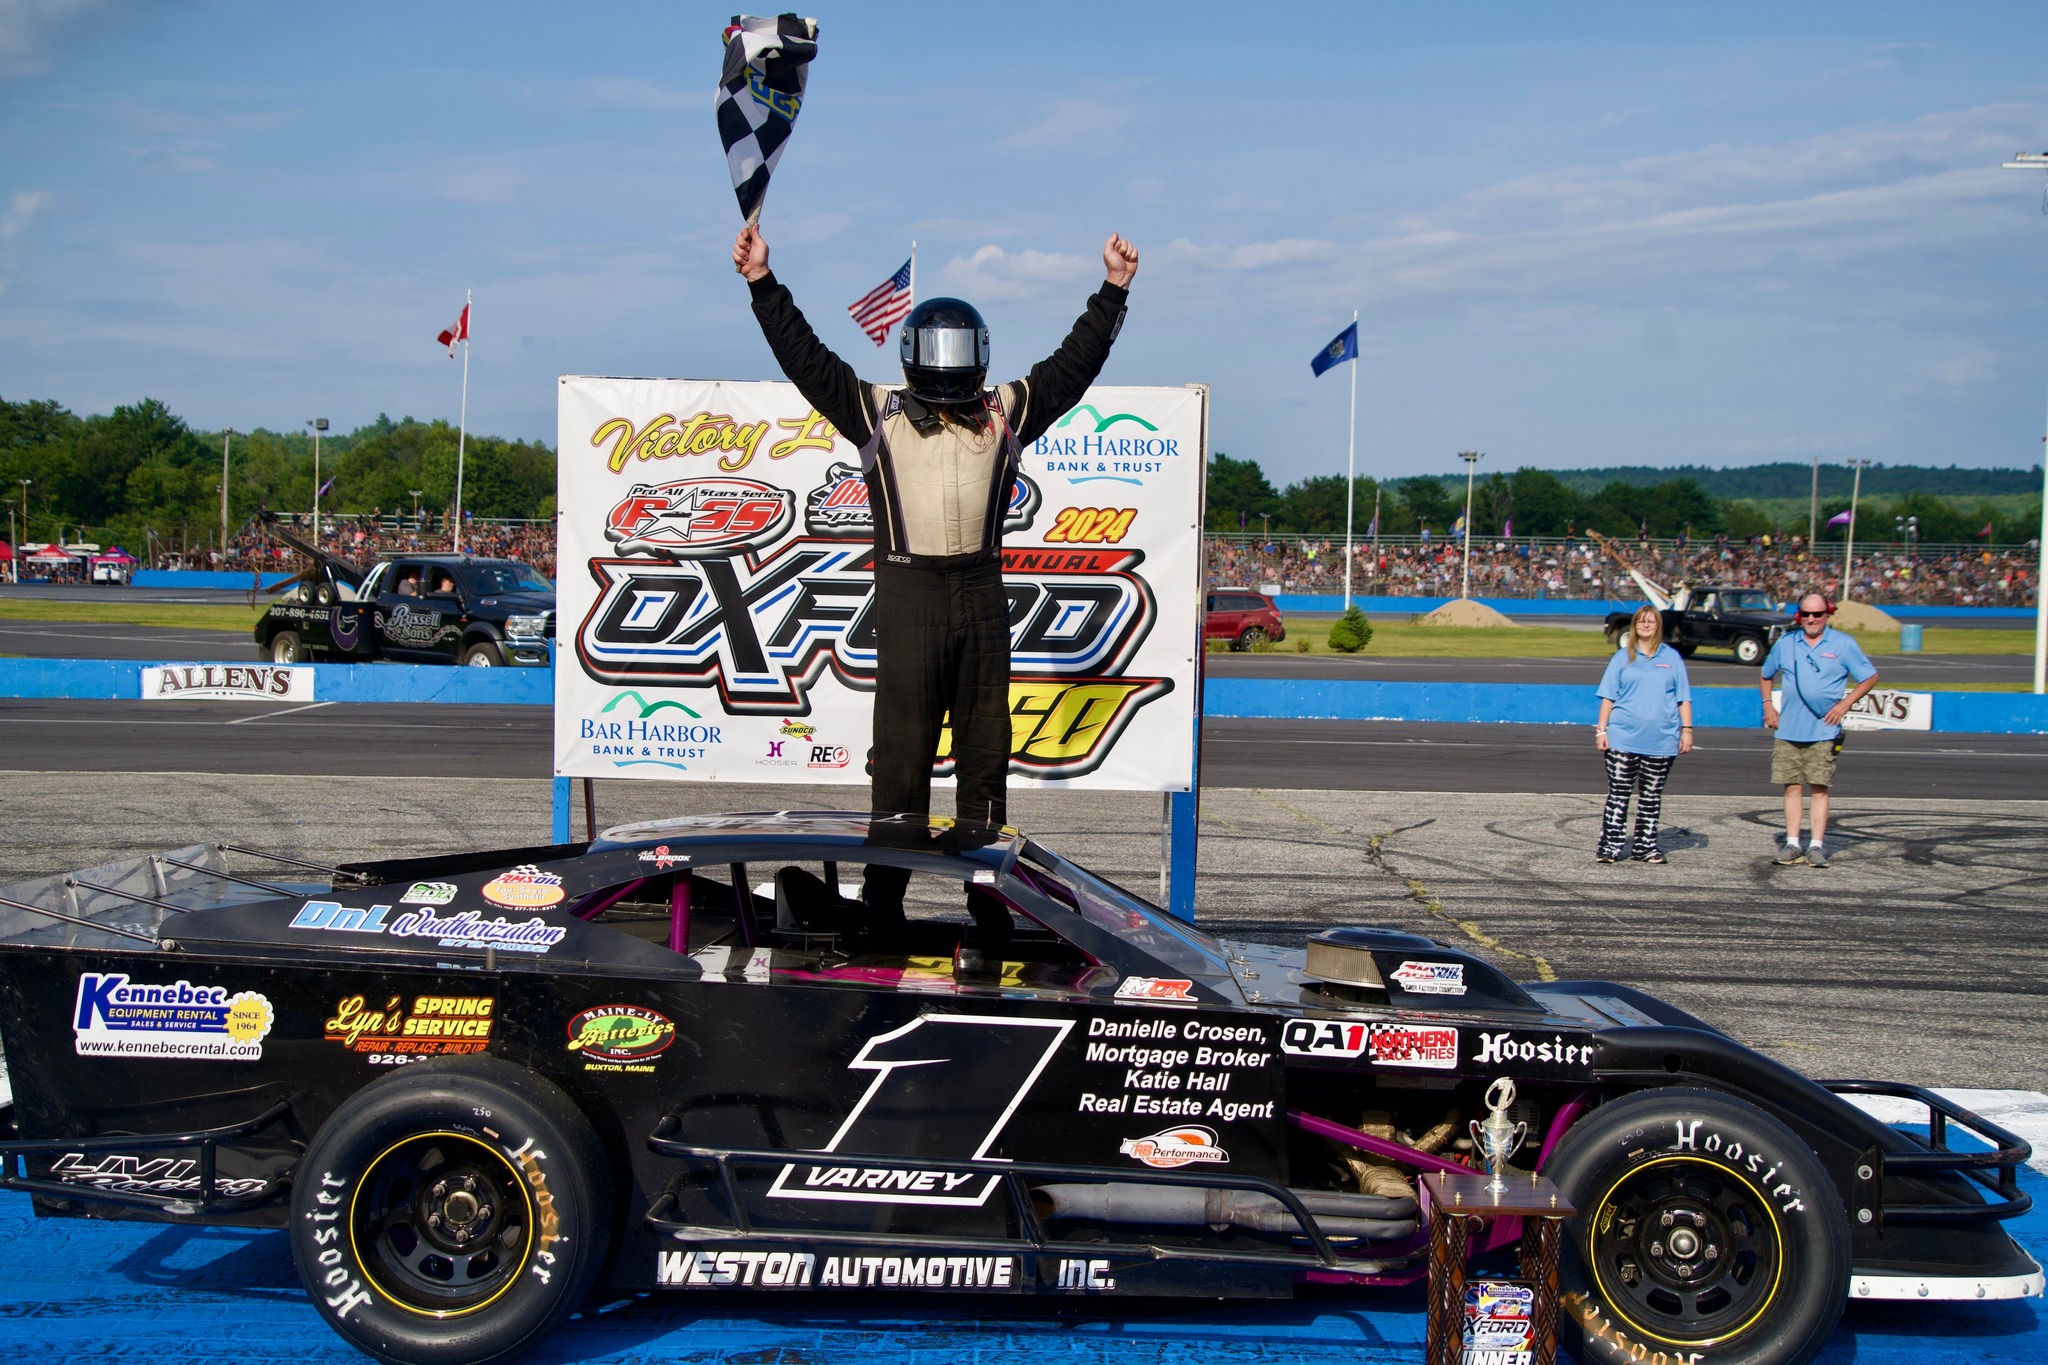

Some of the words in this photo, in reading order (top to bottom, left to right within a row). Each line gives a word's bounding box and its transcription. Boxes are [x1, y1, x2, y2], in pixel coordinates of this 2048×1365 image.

[591, 412, 771, 474] Victory
[1035, 435, 1076, 455] BAR
[1083, 435, 1179, 457] HARBOR
[1047, 461, 1089, 472] BANK
[1097, 461, 1106, 472] &
[1114, 462, 1162, 473] TRUST
[632, 487, 657, 495] Pro
[662, 487, 684, 496] All
[698, 488, 740, 497] Stars
[741, 490, 786, 498] Series
[1043, 507, 1138, 543] 2024
[1001, 554, 1101, 570] NNUAL
[388, 604, 441, 630] Russell
[593, 558, 1123, 674] OXFD
[401, 624, 432, 640] Sons
[159, 666, 291, 695] ALLEN'S
[581, 719, 620, 739] BAR
[628, 721, 722, 743] HARBOR
[593, 745, 634, 756] BANK
[641, 747, 650, 757] &
[658, 747, 706, 759] TRUST
[499, 874, 562, 886] AMSOIL
[502, 892, 547, 901] Synthetic
[391, 908, 566, 944] Weatherization
[1397, 964, 1460, 979] AMSOIL
[77, 976, 224, 1030] Kennebec
[414, 997, 493, 1016] SPRING
[108, 1008, 175, 1019] EQUIPMENT
[176, 1010, 218, 1021] RENTAL
[326, 996, 401, 1046] Lyn's
[403, 1019, 490, 1037] SERVICE
[583, 1007, 663, 1024] MAINE-LY
[568, 1023, 674, 1050] Batteries
[1088, 1017, 1177, 1039] Danielle
[1183, 1021, 1267, 1044] Crosen,
[1285, 1022, 1365, 1052] QA1
[1371, 1030, 1455, 1049] NORTHERN
[80, 1040, 260, 1056] www.kennebecrental.com
[355, 1041, 388, 1052] REPAIR
[395, 1042, 438, 1053] REPLACE
[442, 1043, 471, 1054] BUILD
[472, 1044, 486, 1053] UP
[1085, 1043, 1189, 1068] Mortgage
[1195, 1046, 1271, 1067] Broker
[1377, 1049, 1412, 1061] RACE
[1419, 1048, 1455, 1060] TIRES
[1472, 1031, 1594, 1065] Hoosier
[585, 1064, 622, 1072] BUXTON,
[625, 1065, 655, 1073] MAINE
[1124, 1069, 1180, 1090] Katie
[1186, 1072, 1231, 1091] Hall
[1078, 1093, 1127, 1113] Real
[1133, 1095, 1202, 1116] Estate
[1206, 1098, 1274, 1121] Agent
[1152, 1148, 1221, 1159] Performance
[1667, 1119, 1804, 1214] Hoosier
[804, 1166, 974, 1191] VARNEY
[305, 1171, 373, 1318] Hoosier
[656, 1251, 816, 1287] WESTON
[820, 1255, 1013, 1288] AUTOMOTIVE
[1057, 1259, 1116, 1290] INC.
[1480, 1285, 1518, 1297] Kennebec
[1463, 1316, 1528, 1335] XFORD
[1462, 1351, 1532, 1365] INNER
